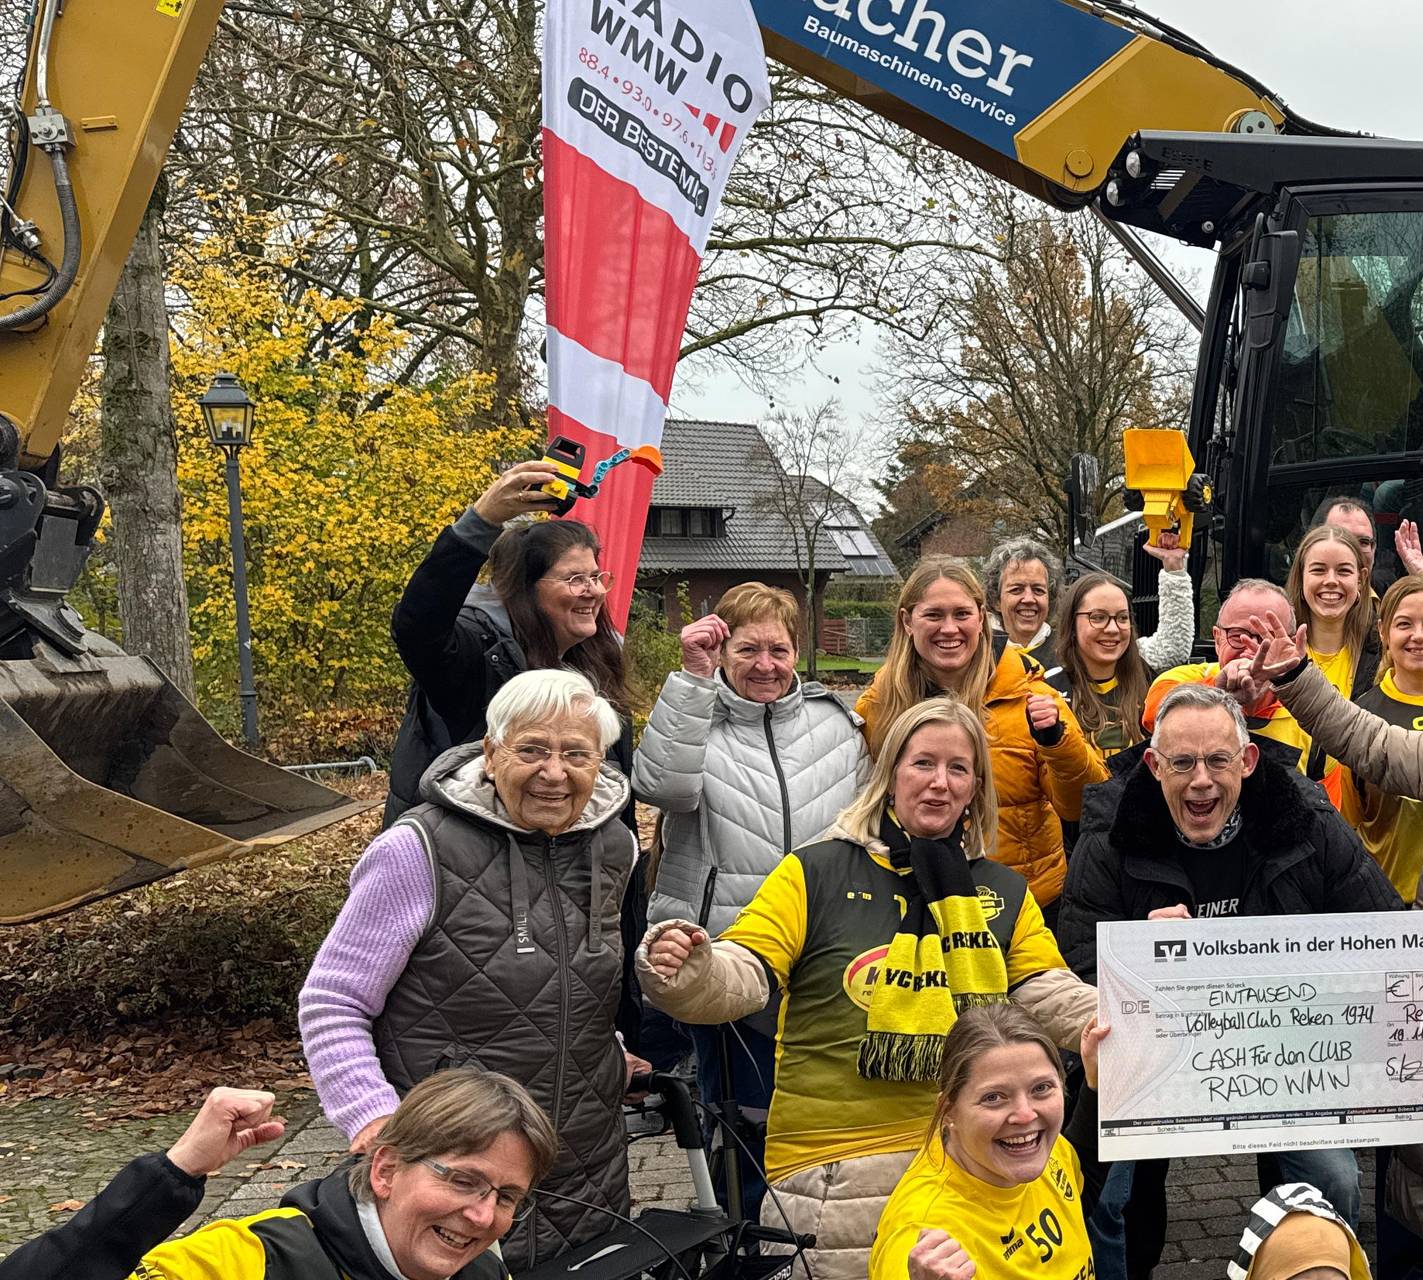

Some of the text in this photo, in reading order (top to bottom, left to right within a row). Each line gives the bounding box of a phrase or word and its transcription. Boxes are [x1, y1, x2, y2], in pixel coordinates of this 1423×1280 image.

[591, 0, 688, 96] WMW
[613, 0, 753, 114] ADIO
[803, 15, 1017, 127] Baumaschinen-Service
[579, 89, 618, 133] DER
[1193, 938, 1280, 956] Volksbank
[1285, 938, 1300, 953] in
[1307, 937, 1335, 952] der
[1341, 935, 1396, 951] Hohen
[1121, 1000, 1151, 1014] DE
[1209, 982, 1317, 1007] EINTAUSEND
[1340, 1005, 1376, 1026] 1974
[1192, 1047, 1246, 1071] CASH
[1308, 1040, 1353, 1063] CLUB
[1200, 1074, 1279, 1102] RADIO
[1284, 1064, 1351, 1096] WMW
[1025, 1207, 1063, 1263] 50
